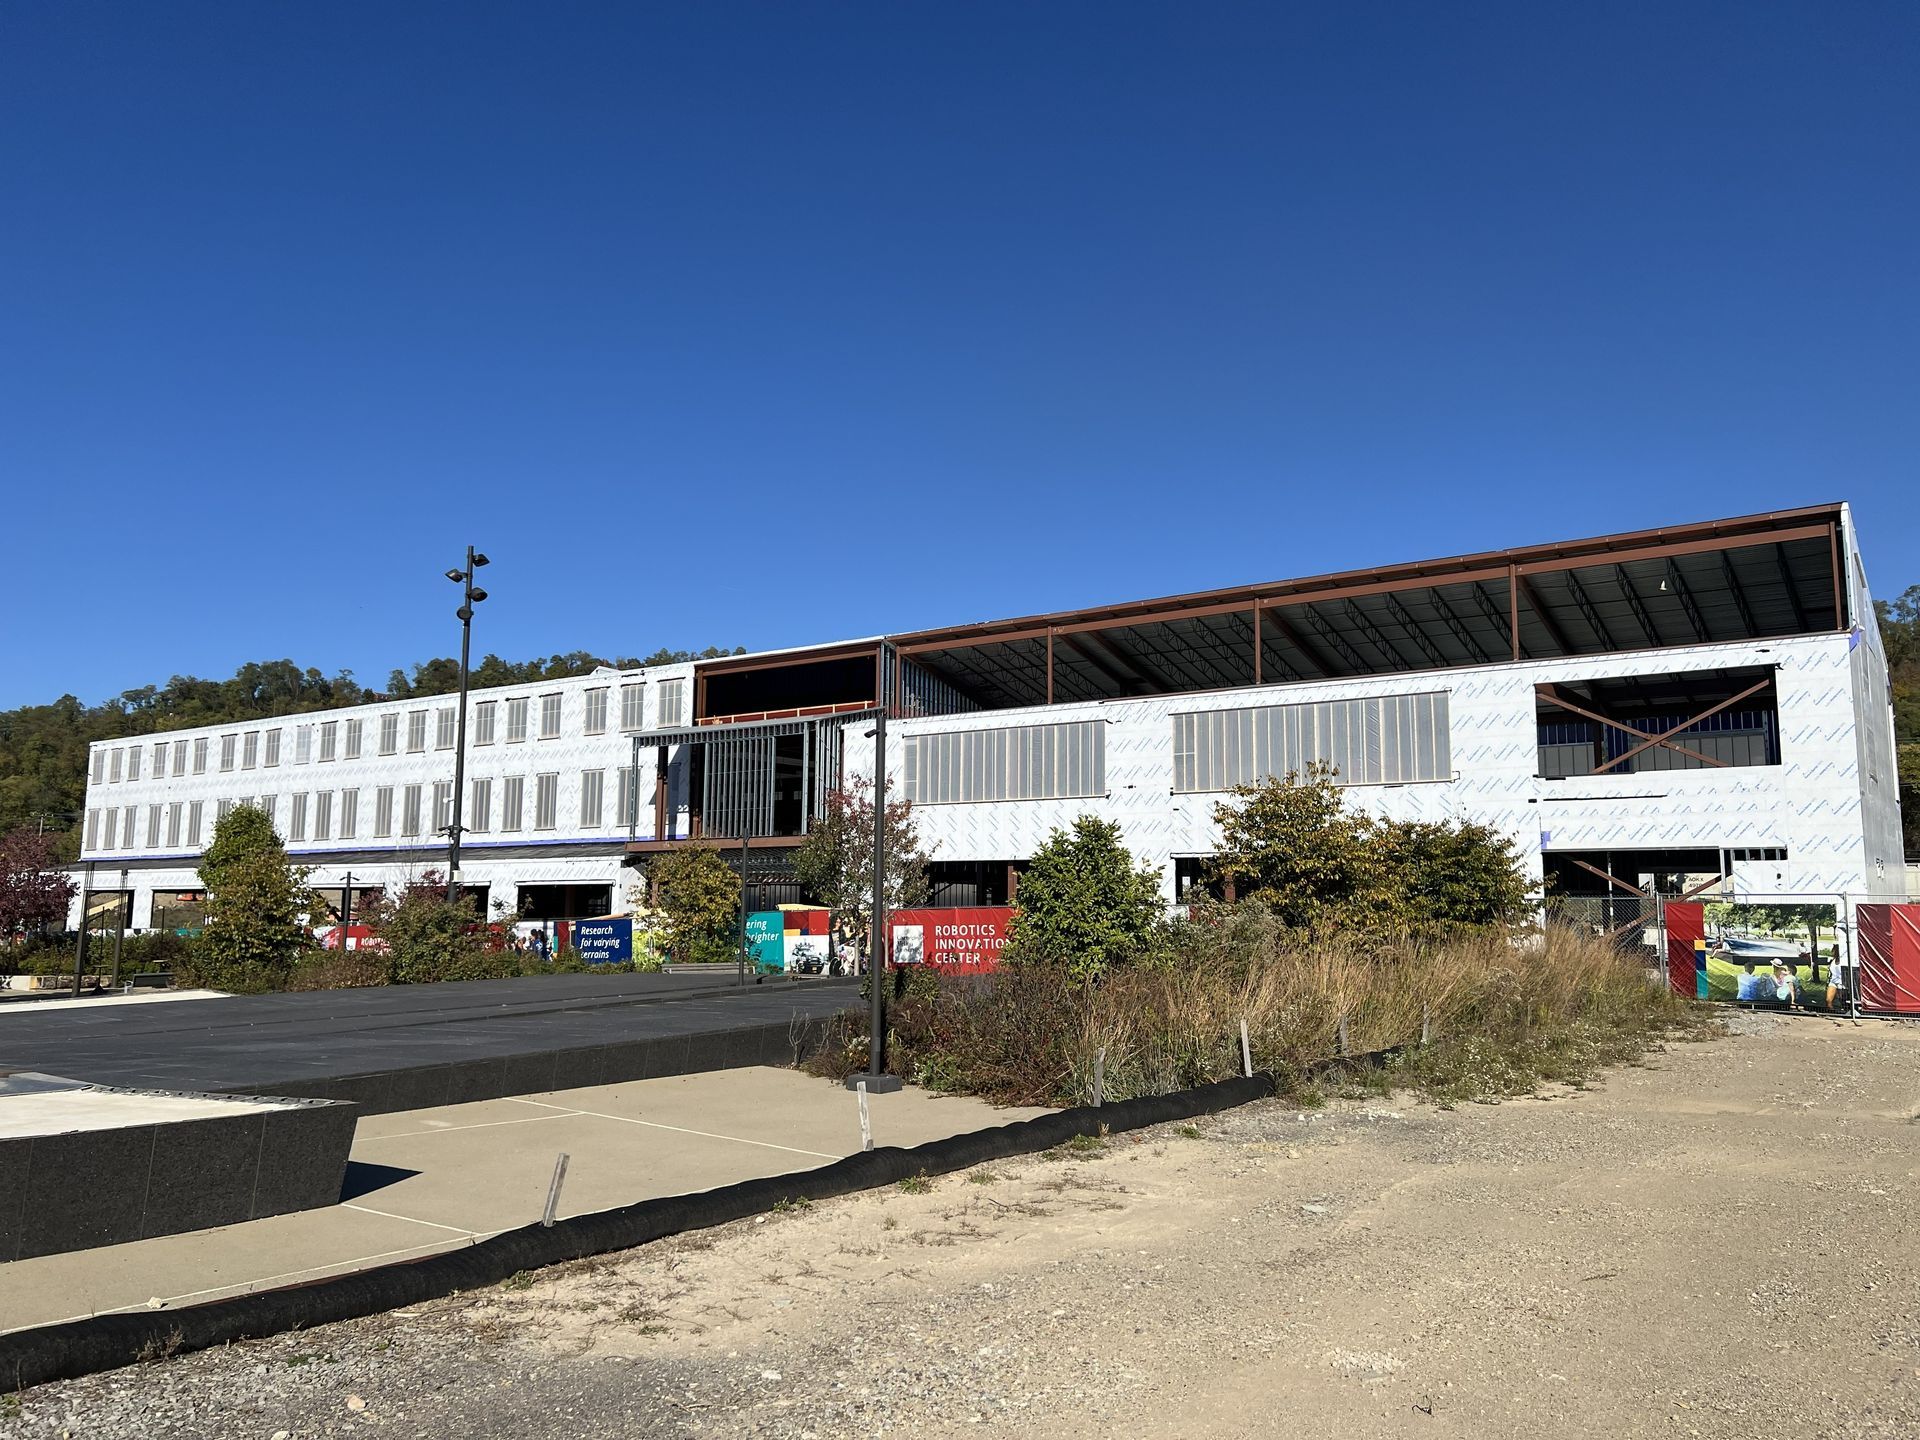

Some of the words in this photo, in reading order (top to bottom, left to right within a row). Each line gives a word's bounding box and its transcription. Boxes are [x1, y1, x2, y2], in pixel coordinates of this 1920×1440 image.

[581, 925, 613, 935] Research
[746, 919, 767, 931] ering
[935, 924, 995, 936] ROBOTICS
[580, 937, 593, 949] for
[593, 938, 620, 949] varying
